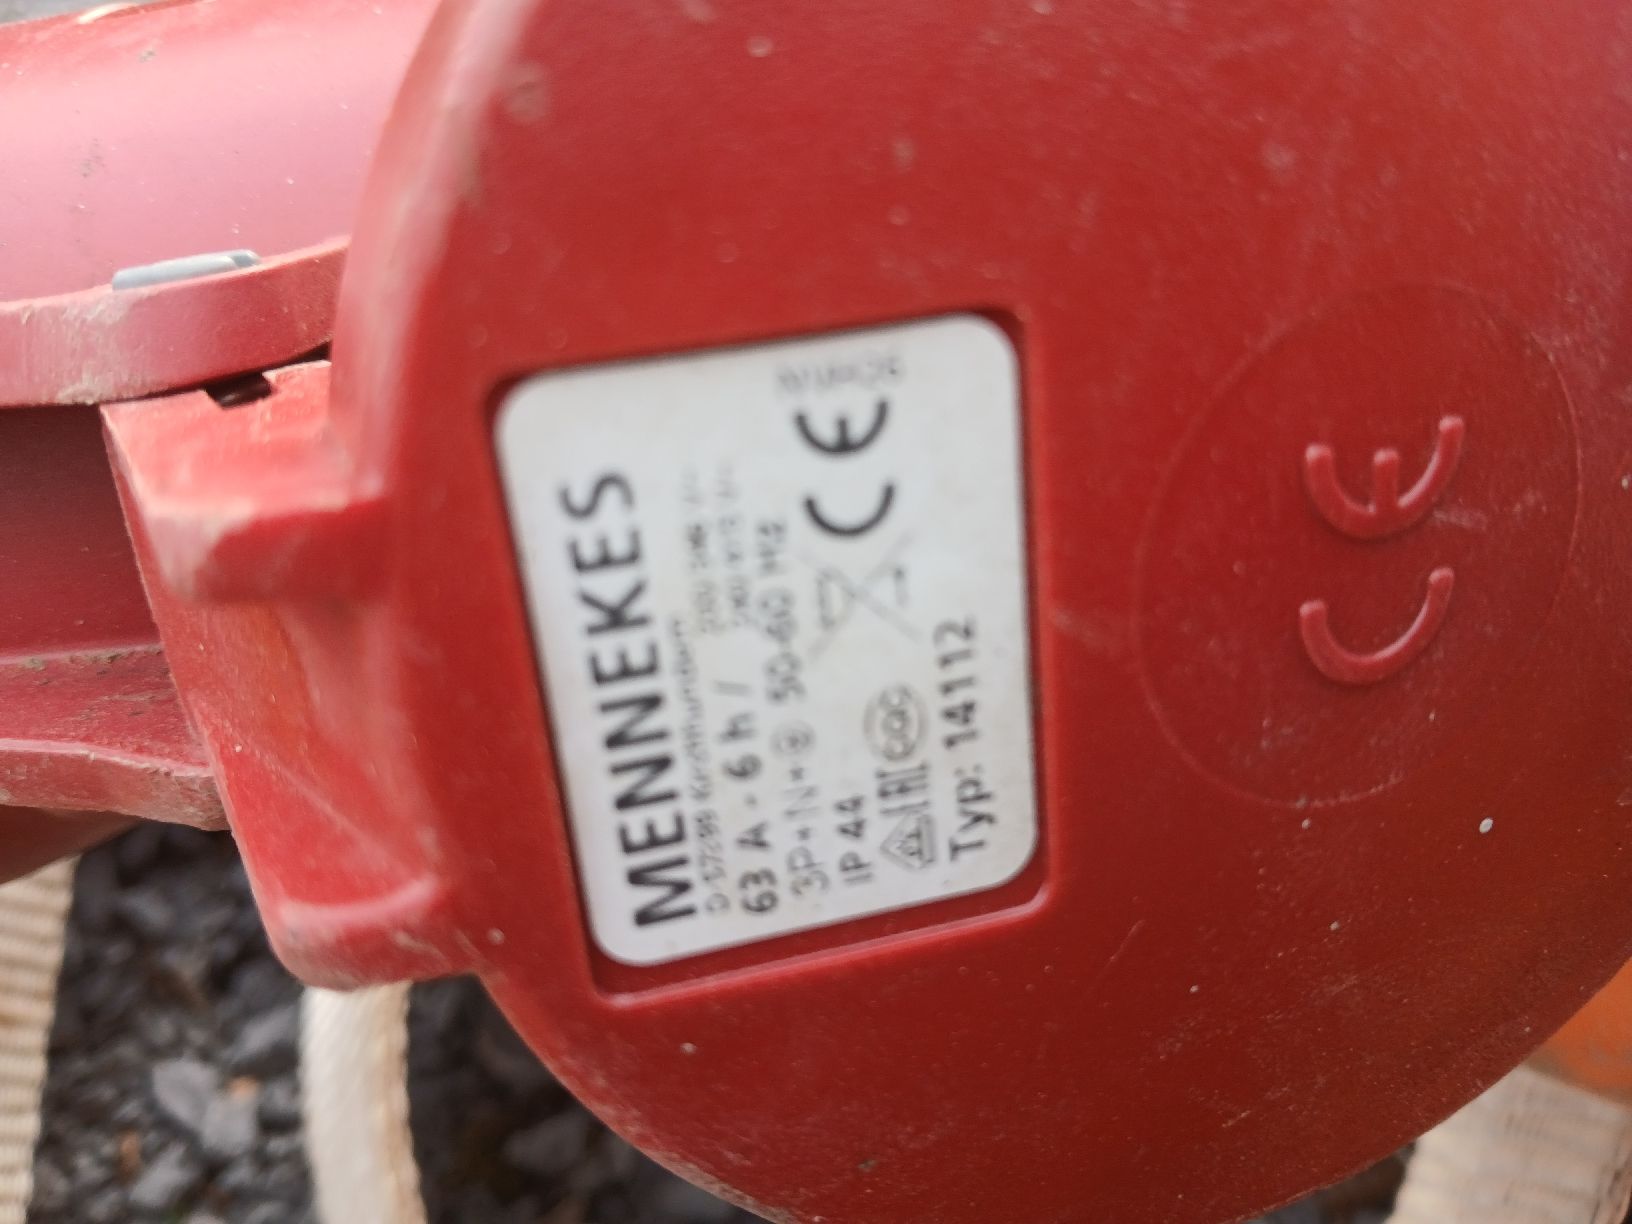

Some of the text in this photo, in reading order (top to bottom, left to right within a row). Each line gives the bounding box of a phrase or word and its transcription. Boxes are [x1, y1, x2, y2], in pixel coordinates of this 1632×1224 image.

[794, 400, 893, 538] CE
[1300, 415, 1464, 684] CE
[560, 471, 696, 927] MENNEKES
[716, 711, 757, 743] h
[932, 617, 996, 862] Typ: 14112
[721, 753, 763, 782] 6
[735, 822, 771, 851] A
[833, 795, 873, 886] IP 44
[739, 869, 780, 915] 63
